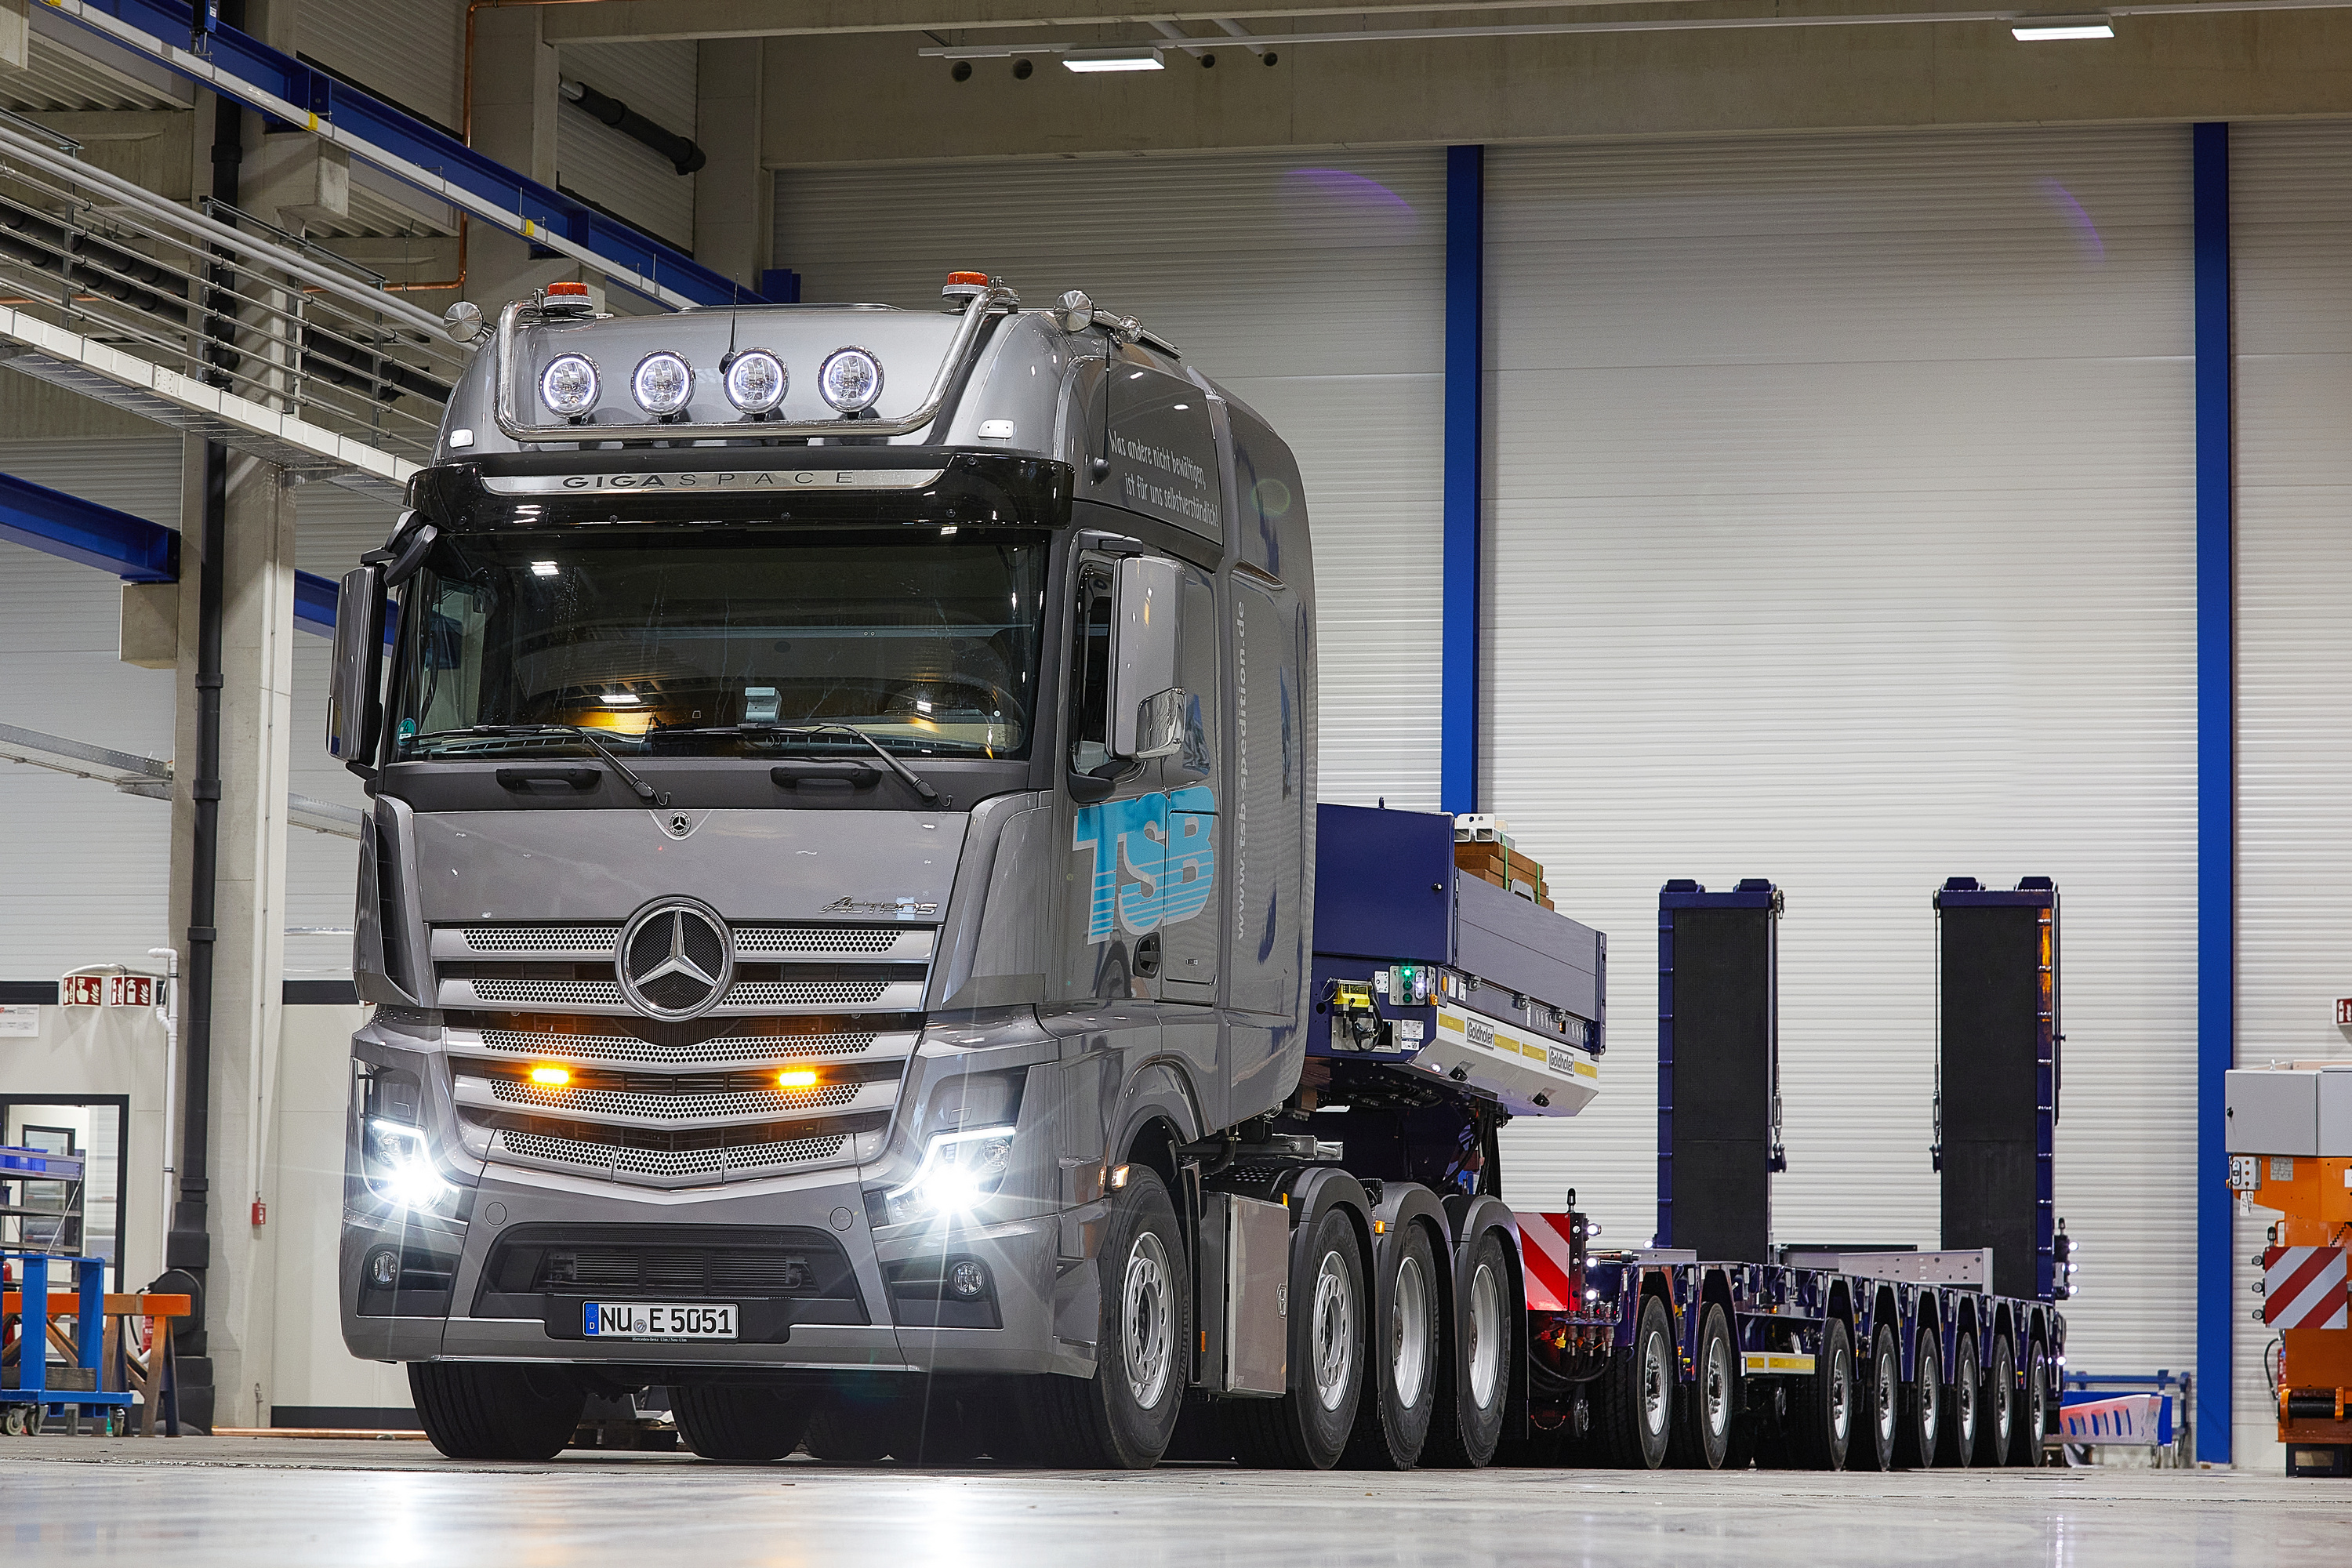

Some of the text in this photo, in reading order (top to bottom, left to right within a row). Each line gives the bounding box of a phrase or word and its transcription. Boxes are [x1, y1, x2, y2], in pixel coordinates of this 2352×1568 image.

[1108, 428, 1207, 490] Was andere nicht bewältigen,
[1124, 472, 1218, 528] ist für uns selbstverständlich!
[1237, 601, 1247, 940] www.tsb-spedition.de
[1073, 786, 1215, 946] TSB
[1468, 1021, 1494, 1046] Goldhofer
[601, 1307, 732, 1334] NU E 5051
